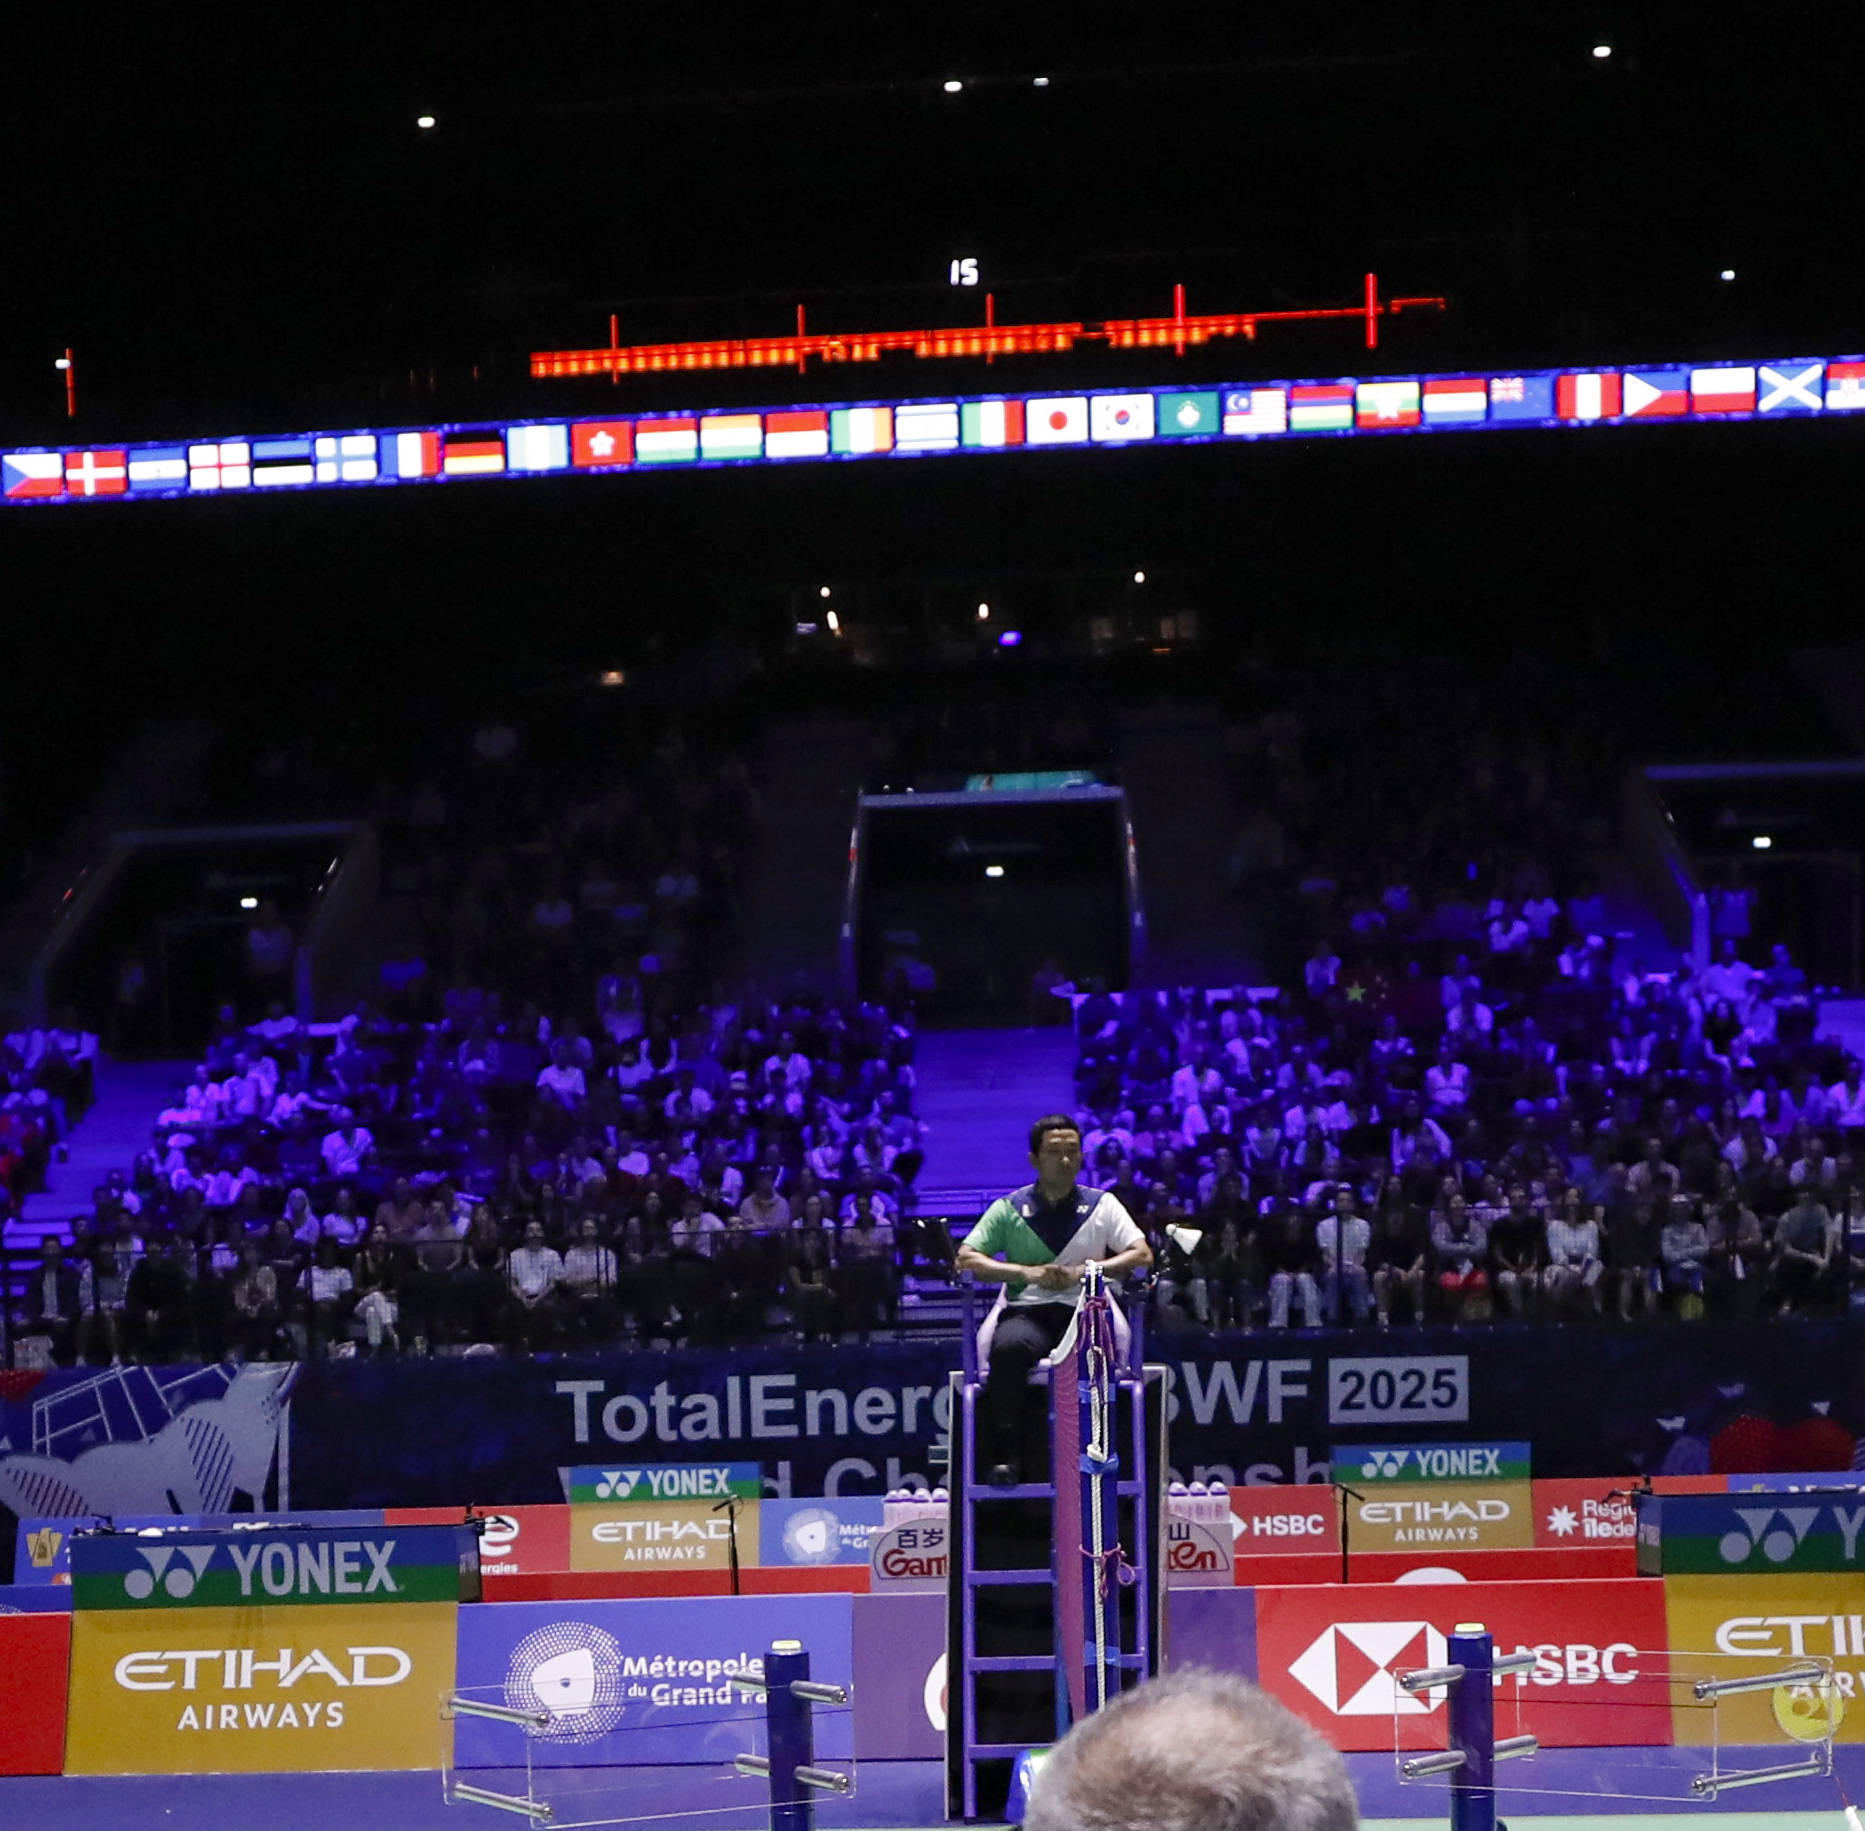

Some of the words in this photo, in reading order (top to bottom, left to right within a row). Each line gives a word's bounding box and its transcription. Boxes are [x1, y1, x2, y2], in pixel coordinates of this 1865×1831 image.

[555, 1374, 949, 1443] TotalEner
[1338, 1367, 1459, 1411] 2025
[1416, 1449, 1501, 1476] YONEX
[647, 1469, 731, 1496] YONEX
[1359, 1500, 1510, 1523] ETIHAD
[592, 1519, 739, 1542] ETIHAD
[1252, 1514, 1325, 1536] HSBC
[1395, 1527, 1478, 1542] AIRWAYS
[898, 1528, 944, 1549] 百岁
[624, 1546, 706, 1561] AIRWAYS
[228, 1540, 399, 1596] YONEX
[114, 1646, 413, 1691] ETIHAD
[623, 1652, 764, 1683] Métropole
[628, 1683, 648, 1698] du
[651, 1681, 732, 1707] Grand
[178, 1701, 345, 1732] AIRWAYS
